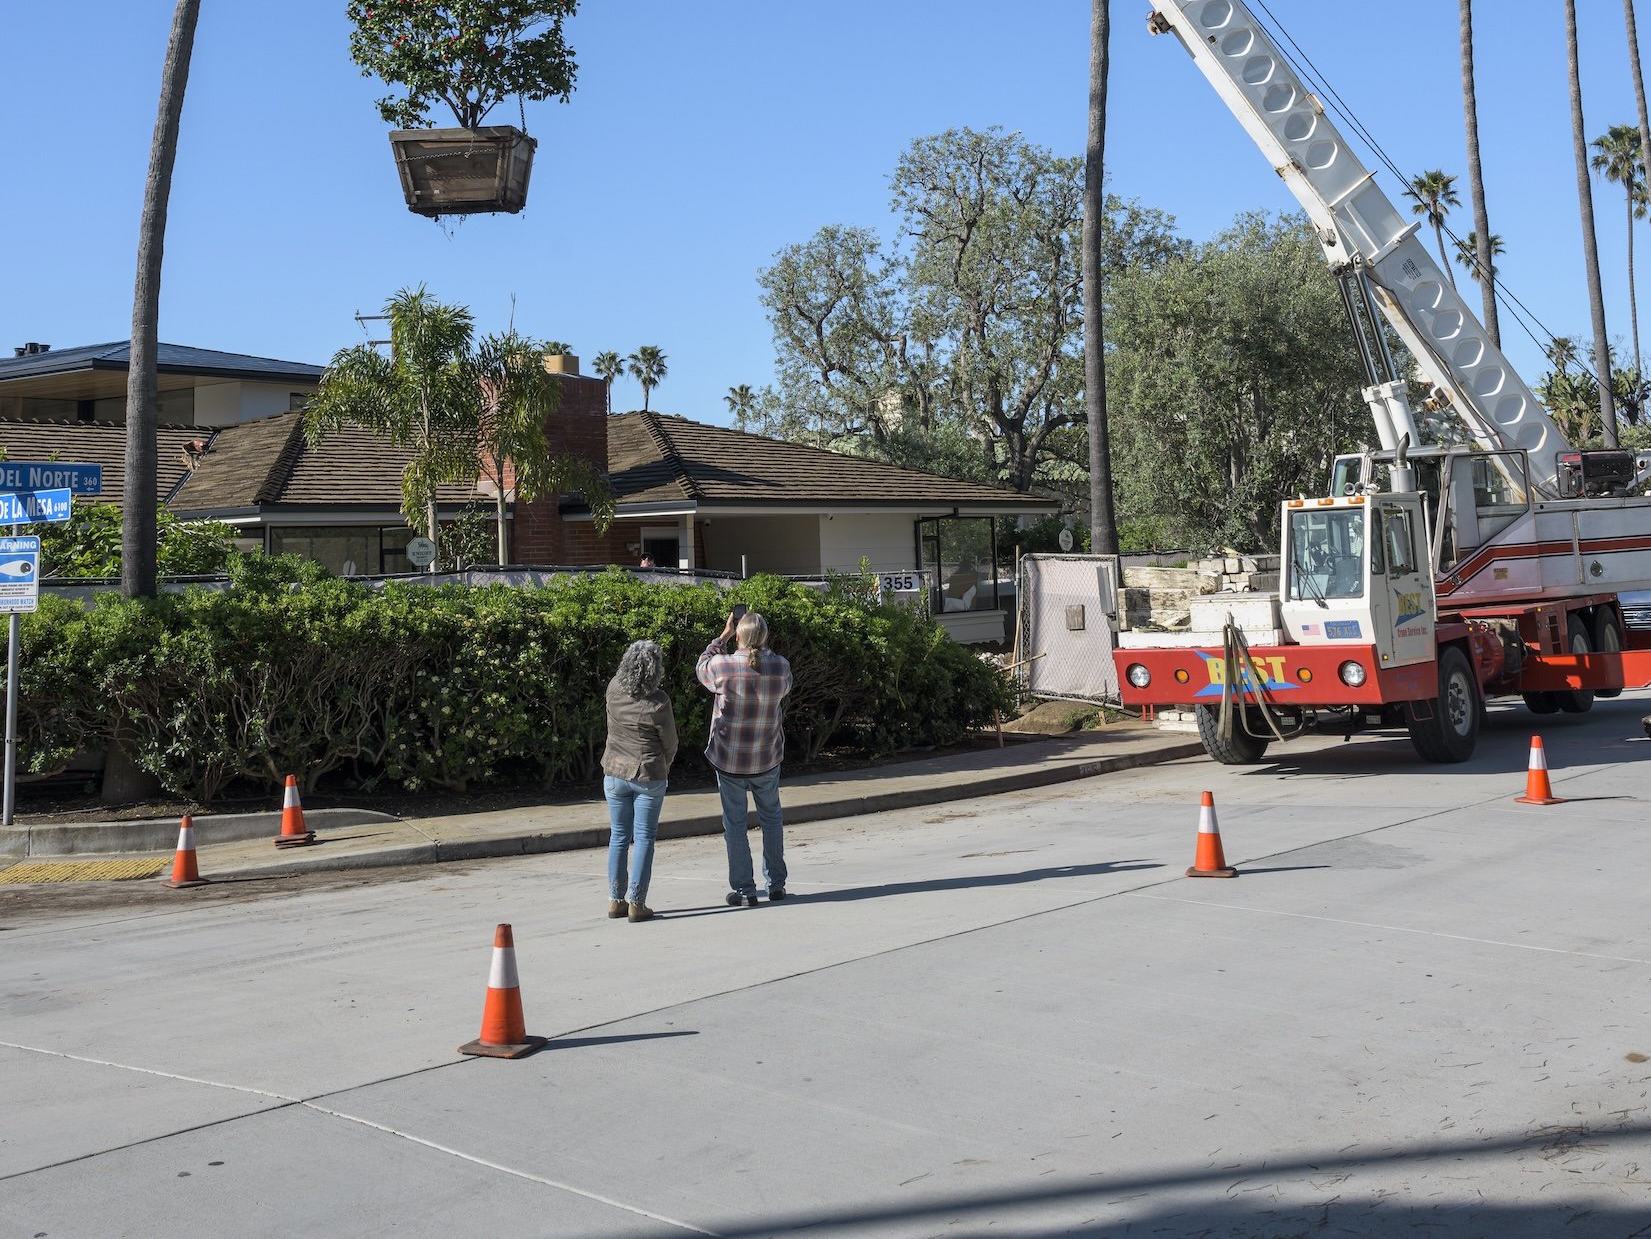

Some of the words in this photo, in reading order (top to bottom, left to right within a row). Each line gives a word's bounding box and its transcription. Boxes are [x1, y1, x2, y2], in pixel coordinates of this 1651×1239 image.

[29, 467, 79, 488] NORTE
[83, 477, 98, 486] 360
[12, 498, 23, 519] LA
[26, 497, 53, 517] MESA
[883, 576, 913, 590] 355
[1397, 592, 1421, 615] BEST
